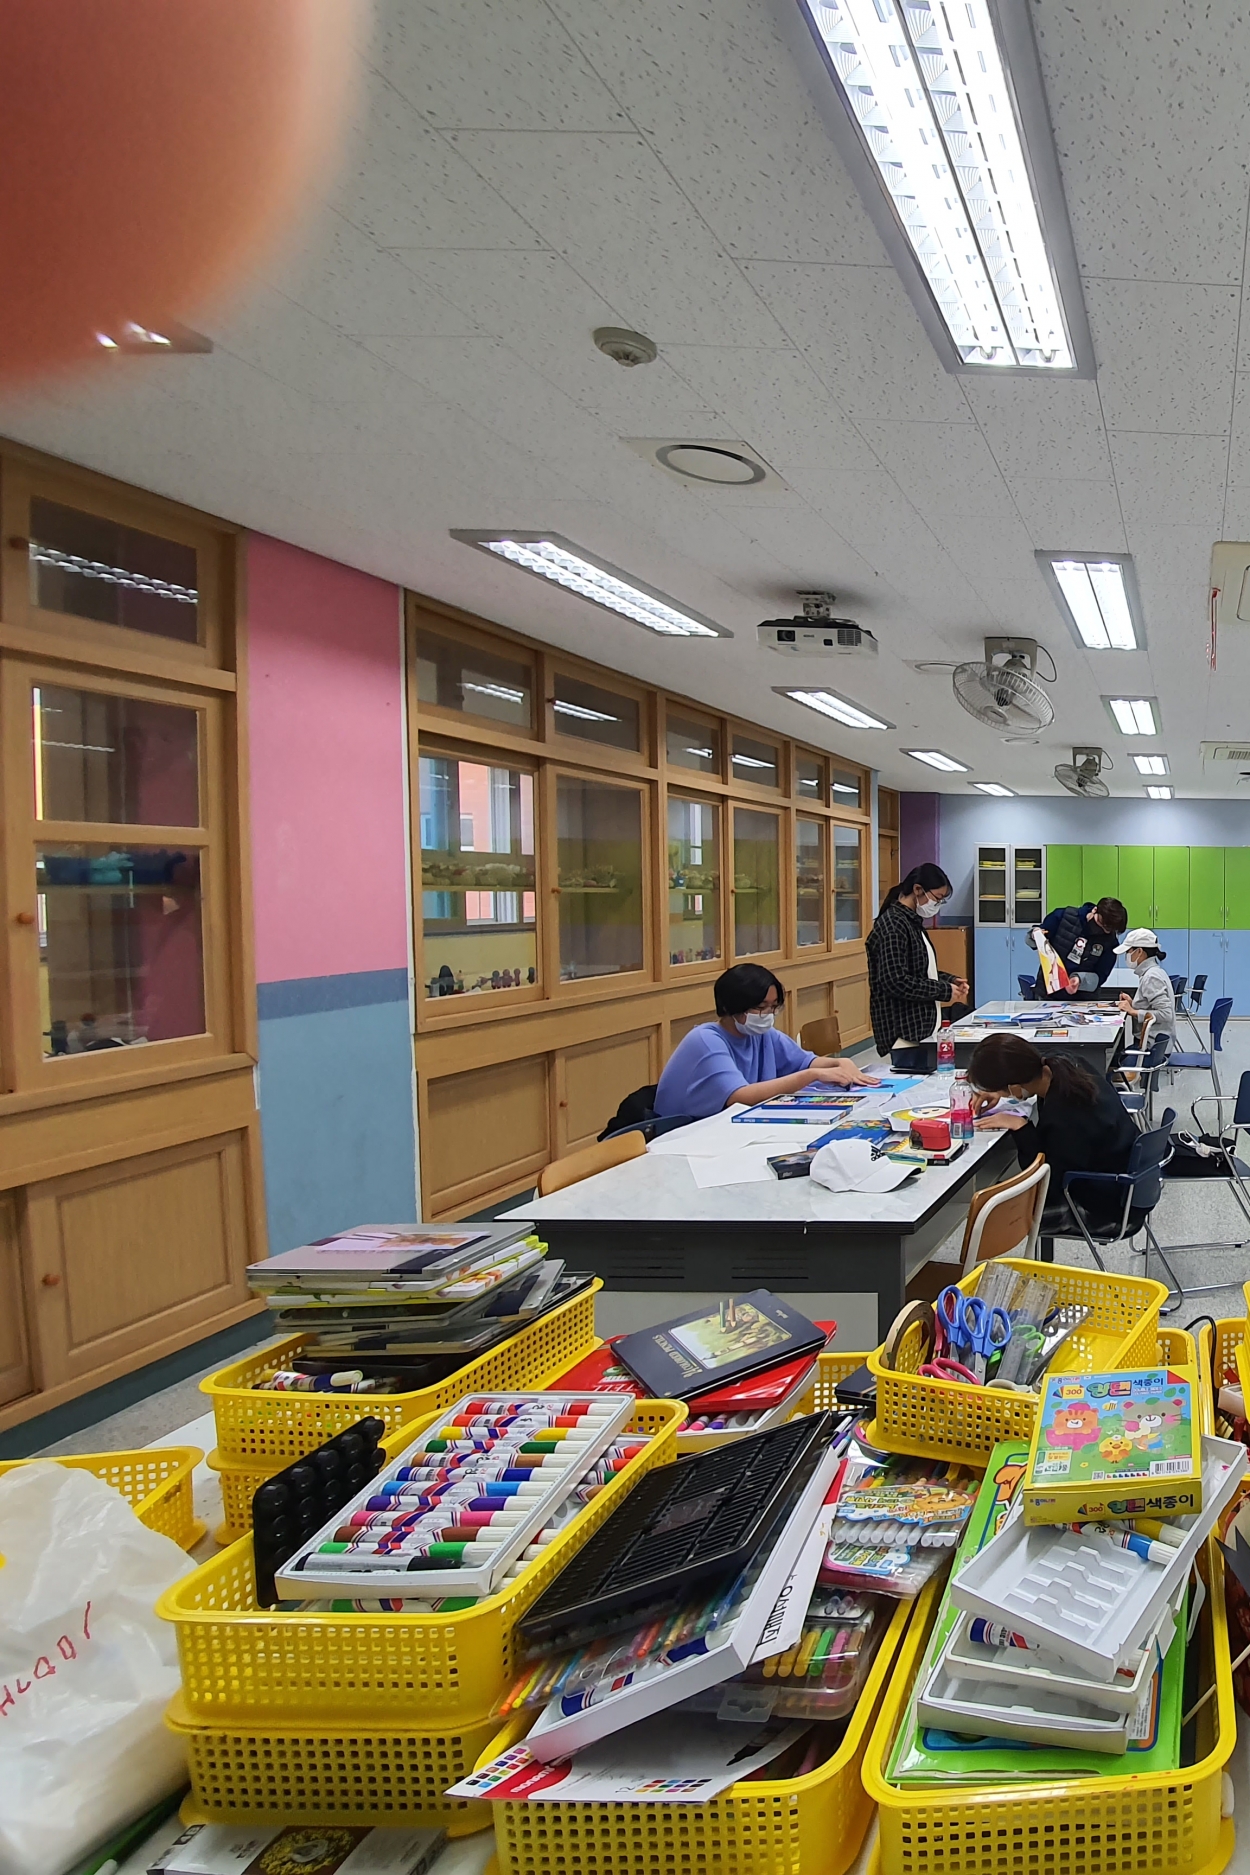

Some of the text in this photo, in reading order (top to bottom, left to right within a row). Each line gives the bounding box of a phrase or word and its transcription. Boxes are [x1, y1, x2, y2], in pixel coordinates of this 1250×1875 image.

[1132, 1377, 1164, 1387] 색종이
[1065, 1388, 1082, 1396] 300
[1146, 1494, 1194, 1509] 색종이
